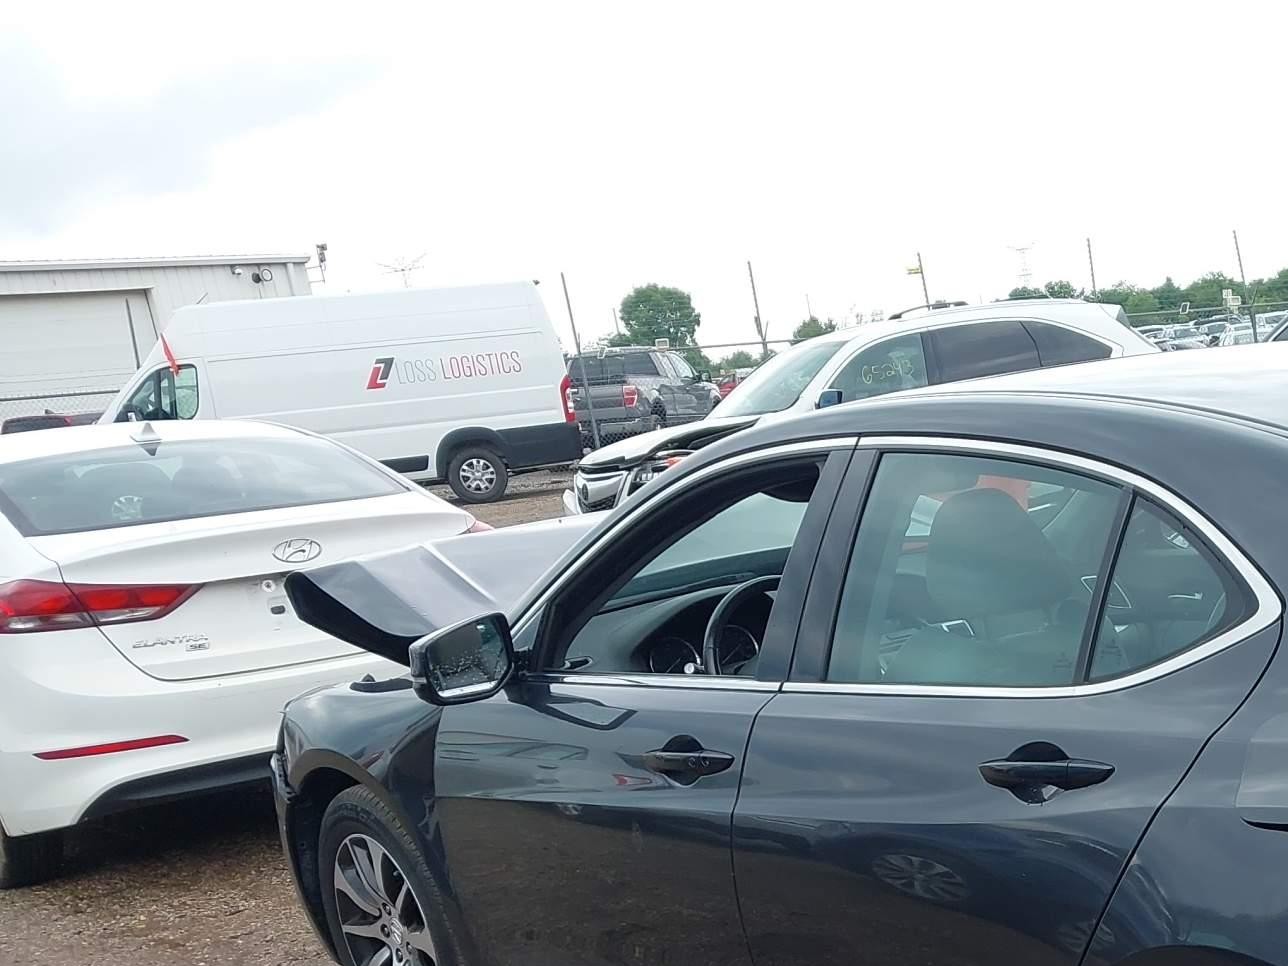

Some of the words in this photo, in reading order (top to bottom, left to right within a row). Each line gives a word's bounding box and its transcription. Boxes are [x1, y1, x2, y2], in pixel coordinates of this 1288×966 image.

[394, 358, 437, 385] LOSS
[439, 350, 522, 380] LOGISTICS
[132, 632, 209, 649] ELANTRA
[188, 642, 208, 650] SE
